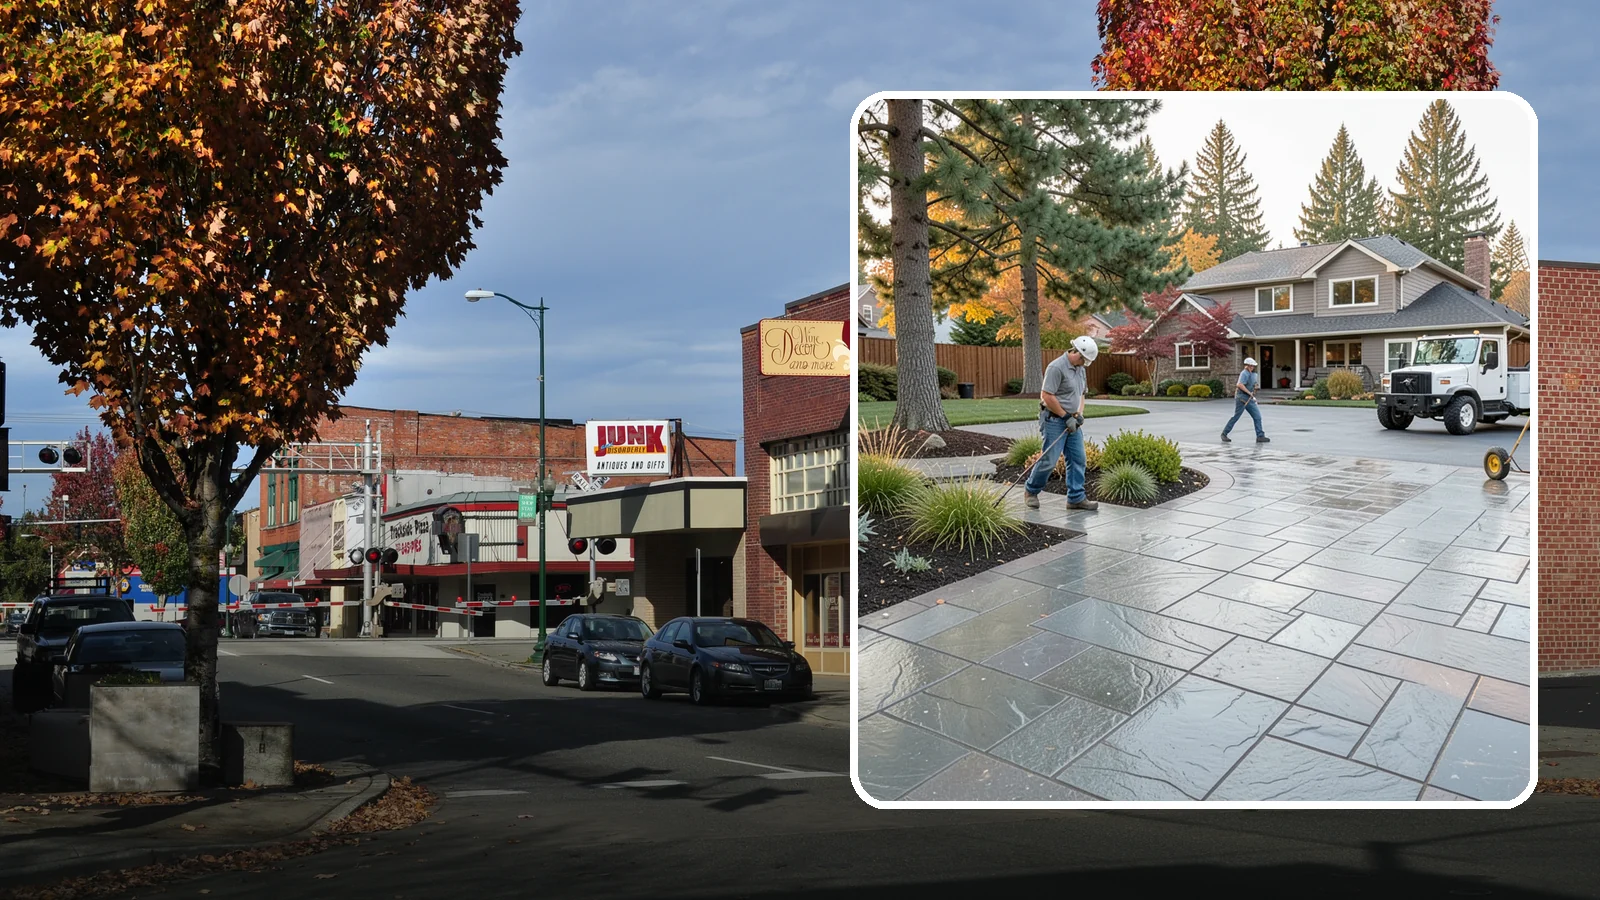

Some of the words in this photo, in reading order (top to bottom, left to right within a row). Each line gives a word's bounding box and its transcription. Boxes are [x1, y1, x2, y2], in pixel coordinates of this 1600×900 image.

[791, 325, 823, 344] Wine
[765, 327, 830, 365] Decor
[596, 425, 665, 457] JUNK
[607, 446, 646, 454] DISORDERLY
[597, 461, 628, 470] ANTIQUES
[631, 461, 643, 470] AND
[647, 460, 665, 469] GIFTS
[415, 519, 429, 535] Pizza
